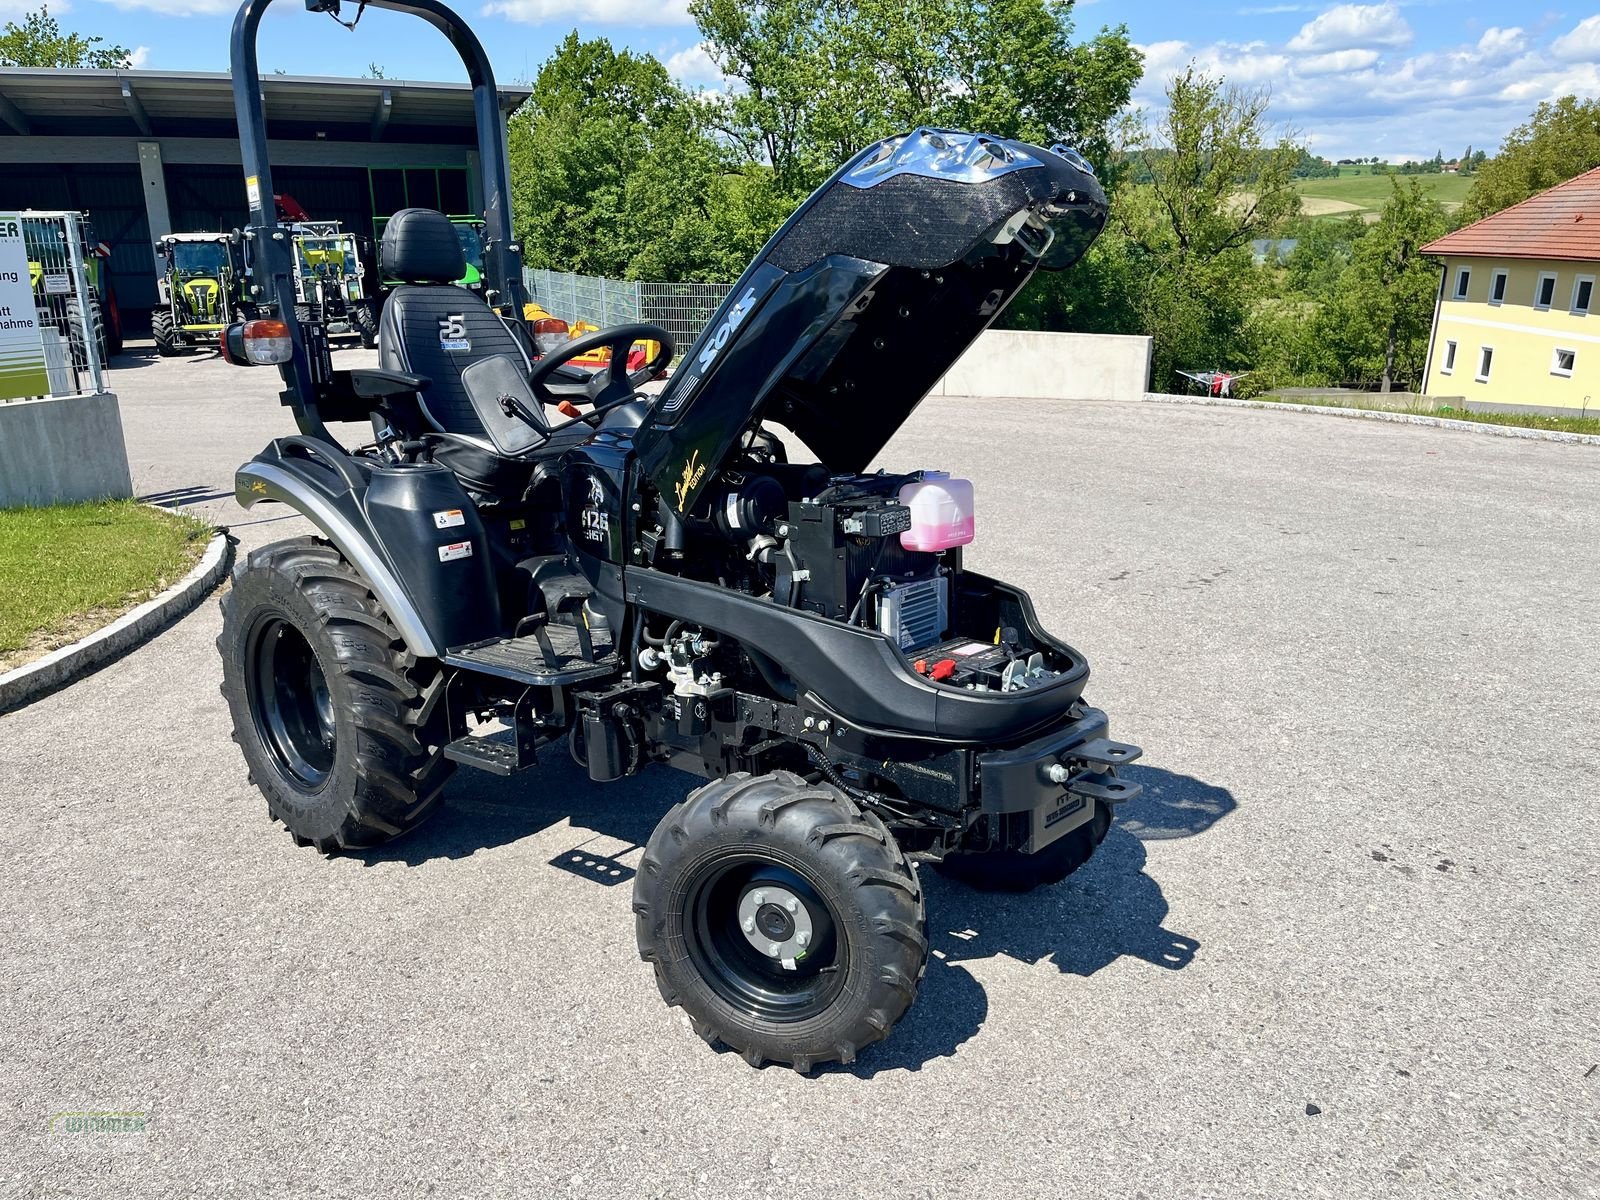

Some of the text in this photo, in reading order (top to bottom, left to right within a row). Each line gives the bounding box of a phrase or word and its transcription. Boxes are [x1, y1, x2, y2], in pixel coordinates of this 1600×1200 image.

[0, 272, 18, 283] ng
[0, 306, 11, 317] tt
[689, 463, 706, 490] EDITION
